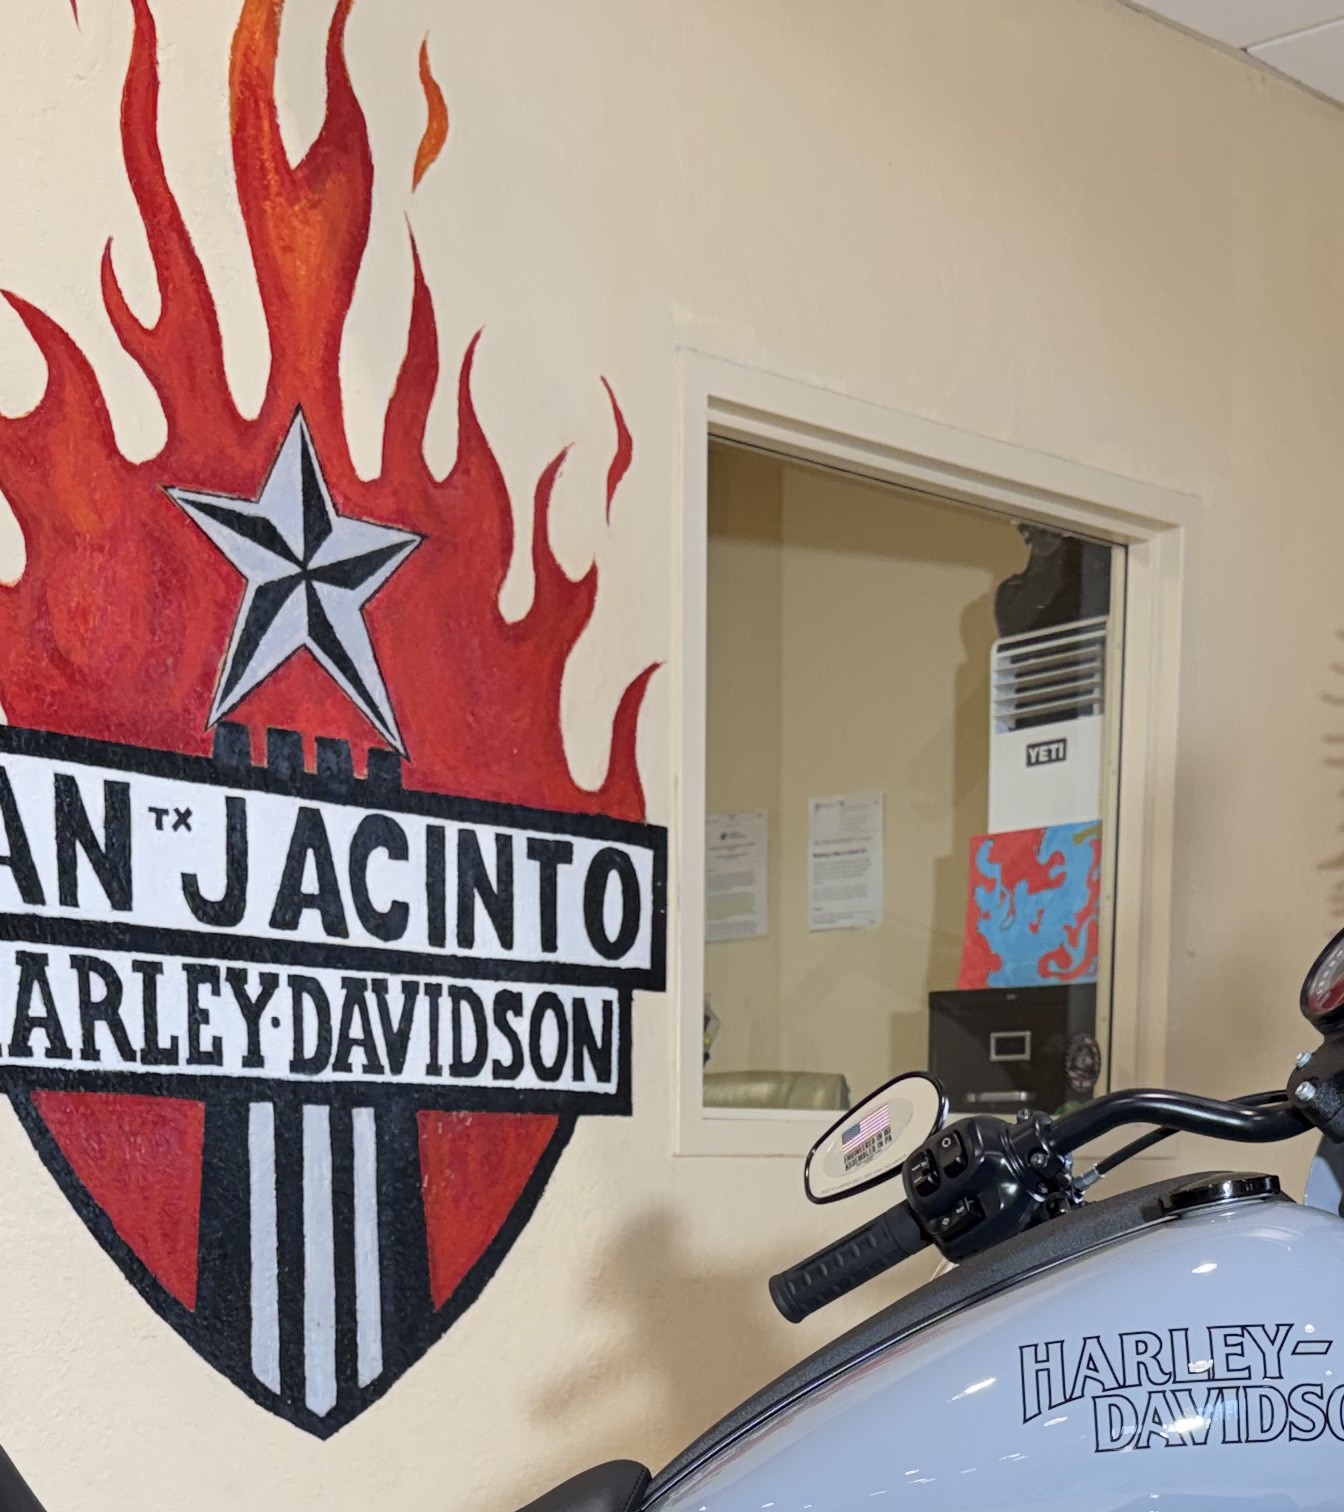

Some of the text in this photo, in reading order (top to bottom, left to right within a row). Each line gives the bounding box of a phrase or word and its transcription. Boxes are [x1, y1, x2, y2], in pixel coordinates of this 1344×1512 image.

[1028, 742, 1065, 764] YETI
[148, 805, 193, 832] TX
[181, 795, 643, 961] JACINTO
[1019, 1323, 1334, 1425] HARLEY-
